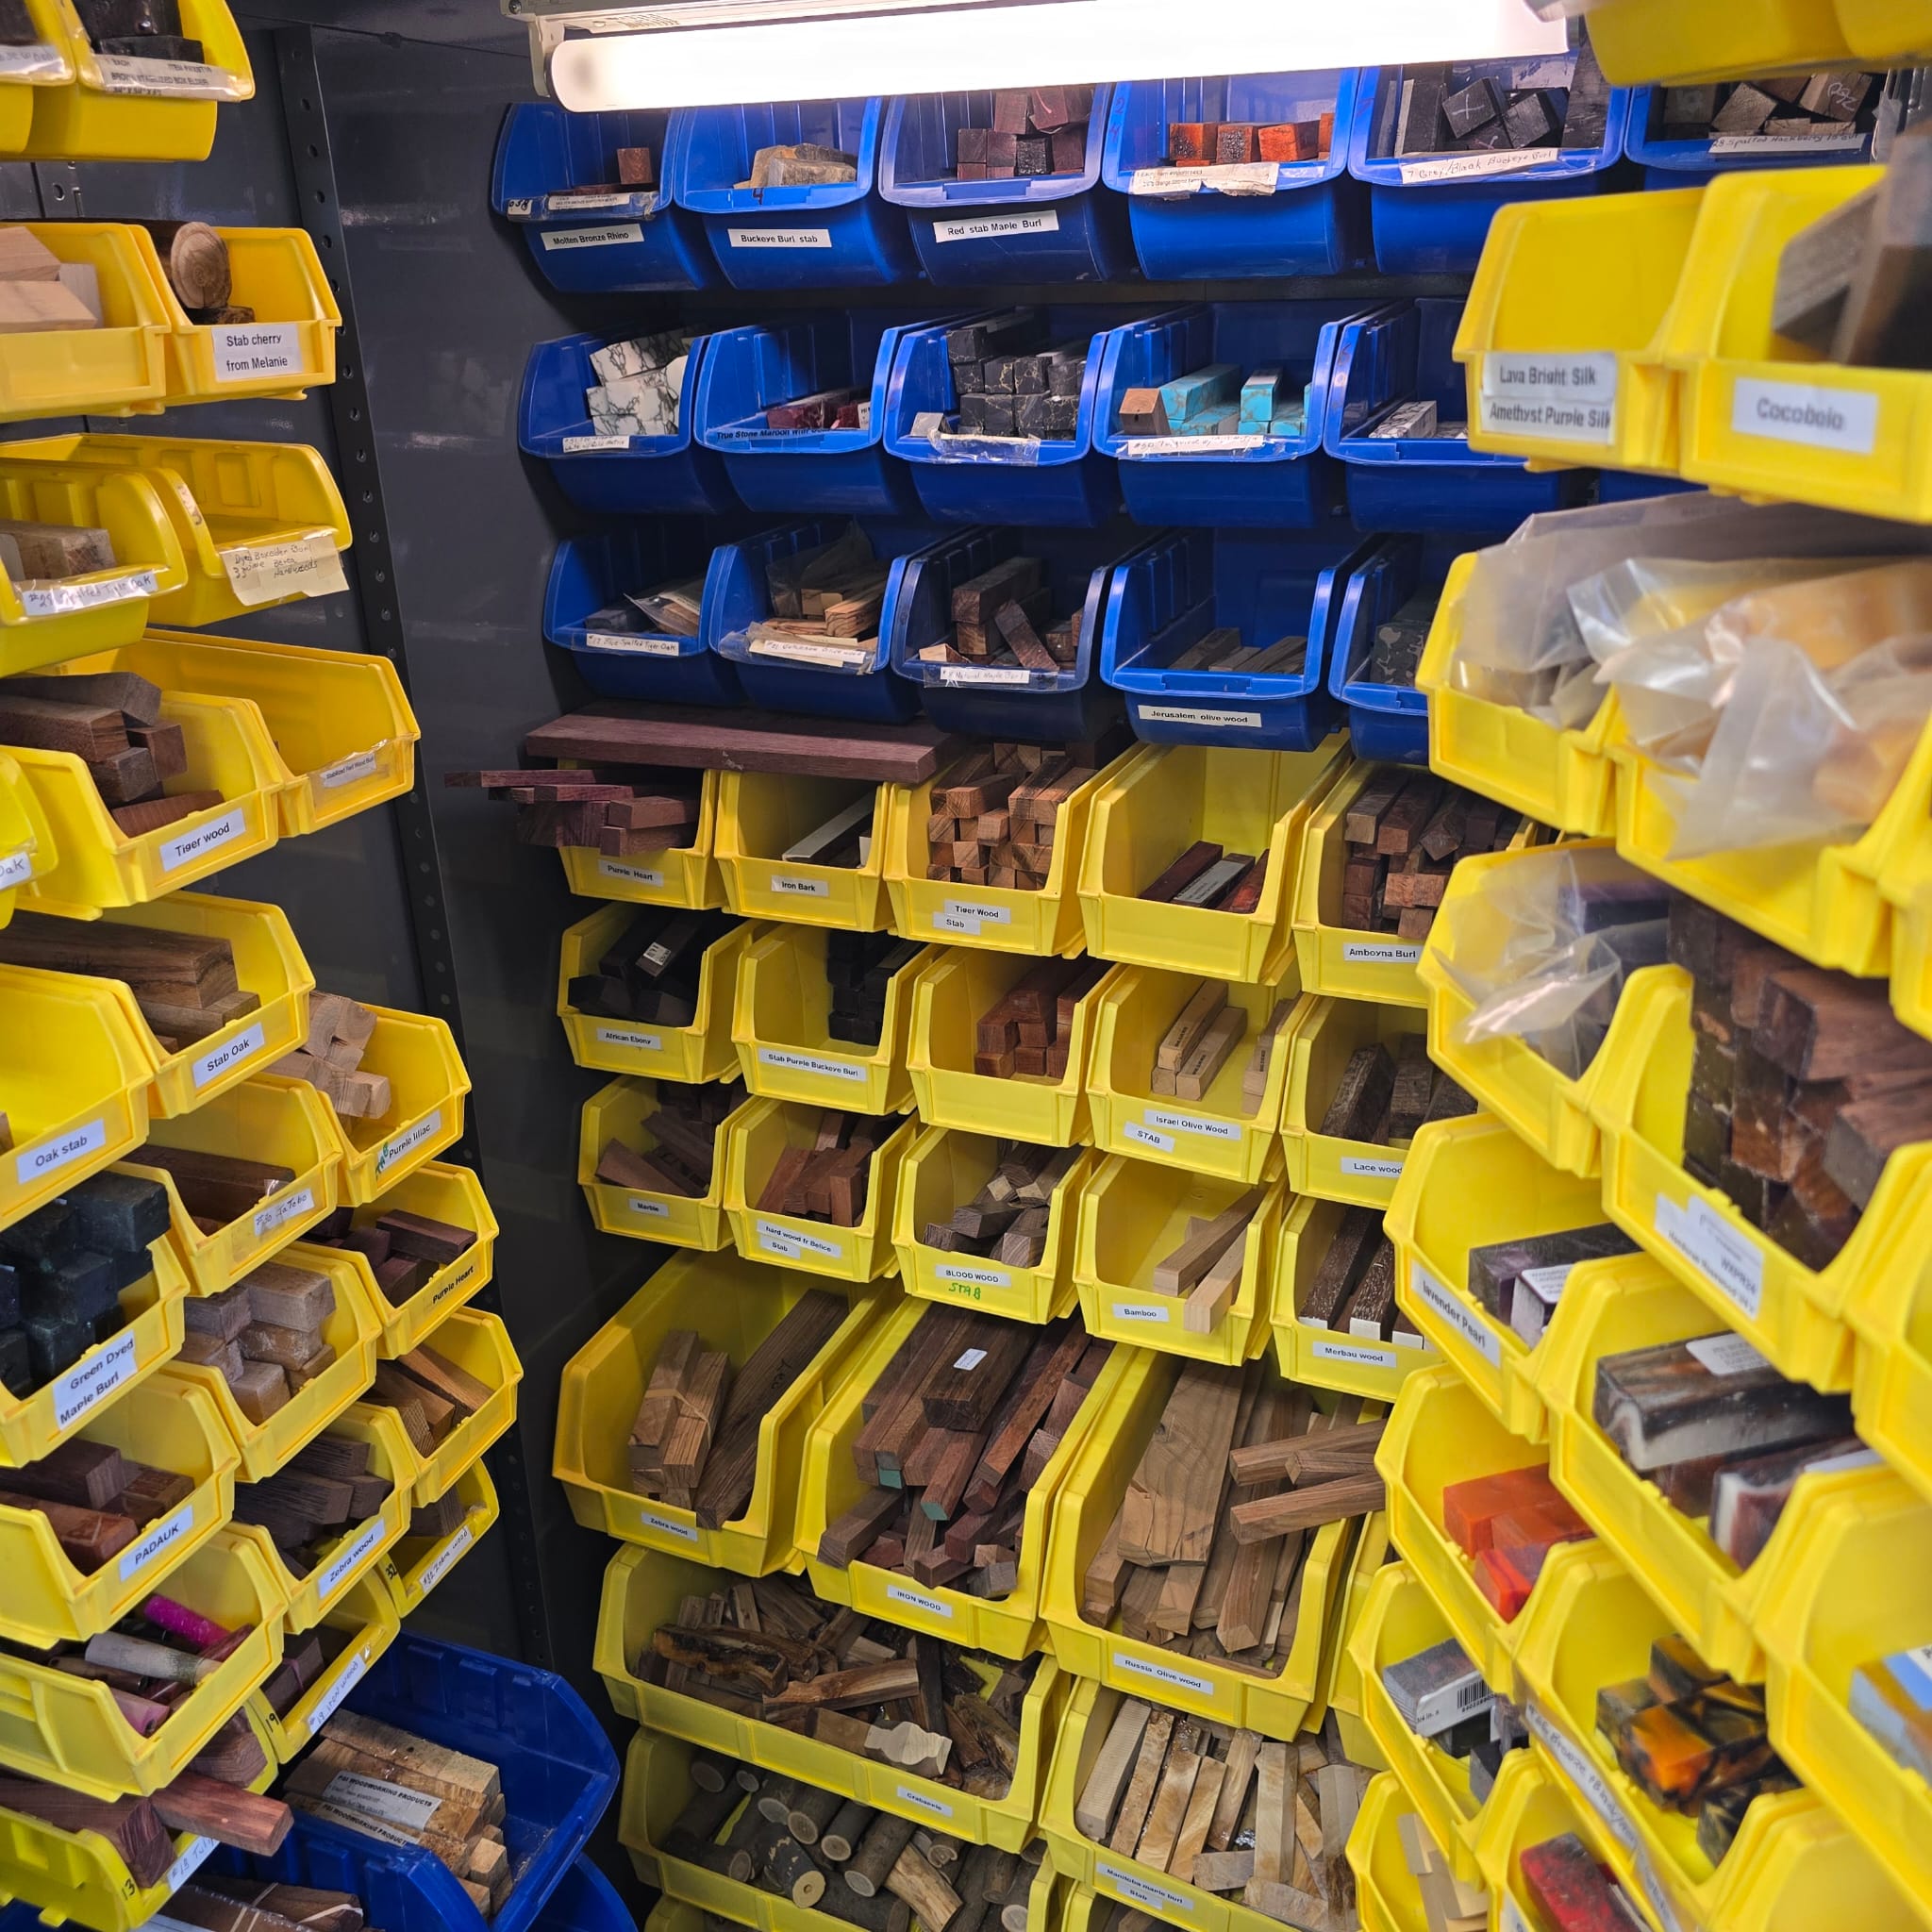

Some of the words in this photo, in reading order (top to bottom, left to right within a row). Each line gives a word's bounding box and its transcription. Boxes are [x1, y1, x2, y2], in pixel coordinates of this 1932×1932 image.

[946, 226, 964, 235] Red
[969, 224, 989, 234] stab
[991, 222, 1017, 232] Maple
[1022, 219, 1041, 228] Burl
[553, 235, 578, 245] Molten
[579, 233, 607, 243] Bronze
[608, 231, 630, 242] Rhino
[741, 234, 776, 243] Buckeye
[777, 234, 795, 242] Burl
[800, 234, 819, 243] stab
[226, 335, 250, 347] Stab
[251, 333, 282, 347] cherry
[226, 359, 251, 372] from
[252, 357, 288, 369] Melanie
[1500, 366, 1524, 384] Lava
[1527, 366, 1565, 386] Bright
[1572, 366, 1595, 385] Silk
[1489, 403, 1543, 425] Amethyst
[1544, 407, 1584, 426] Purple
[1587, 409, 1610, 429] Silk
[1756, 397, 1843, 430] Cocobolo
[717, 430, 734, 440] True
[736, 429, 758, 439] Stone
[760, 428, 791, 438] Maroon
[1150, 710, 1196, 721] Jerusalem
[1200, 712, 1222, 722] olive
[1223, 715, 1248, 724] wood
[175, 838, 201, 857] Tiger
[204, 822, 230, 843] wood
[607, 865, 631, 876] Purple
[633, 871, 653, 881] Heart
[782, 881, 797, 890] Iron
[798, 883, 816, 891] Bark
[955, 905, 975, 914] Tiger
[976, 908, 999, 918] Wood
[945, 919, 964, 928] Stab
[1349, 948, 1392, 958] Amboyna
[1395, 949, 1417, 958] Burl
[606, 1032, 630, 1042] African
[631, 1035, 652, 1045] Ebony
[208, 1052, 230, 1072] Stab
[231, 1039, 250, 1055] Oak
[768, 1053, 786, 1062] Stab
[787, 1057, 810, 1067] Purple
[811, 1061, 841, 1074] Buckeye
[841, 1068, 858, 1076] Burl
[1156, 1115, 1179, 1126] Israel
[1181, 1120, 1204, 1131] Olive
[1205, 1124, 1228, 1135] Wood
[390, 1137, 412, 1158] Purple
[413, 1124, 431, 1141] liliac
[1137, 1129, 1160, 1144] STAB
[35, 1149, 59, 1167] Oak
[61, 1136, 88, 1155] stab
[1354, 1162, 1376, 1172] Lace
[1377, 1165, 1402, 1174] wood
[766, 1225, 781, 1236] hard
[783, 1230, 802, 1242] wood
[772, 1241, 789, 1252] Stab
[433, 1282, 455, 1305] Purple
[455, 1266, 474, 1286] Heart
[945, 1270, 974, 1279] BLOOD
[974, 1273, 999, 1283] WOOD
[948, 1283, 981, 1301] STAB
[1124, 1308, 1157, 1317] Bamboo
[1423, 1280, 1461, 1321] lavender
[1461, 1309, 1486, 1349] Pearl
[1325, 1347, 1357, 1358] Merbau
[1359, 1352, 1383, 1362] wood
[70, 1357, 104, 1390] Green
[105, 1339, 134, 1367] Dyed
[60, 1394, 93, 1424] Maple
[95, 1372, 119, 1395] Burl
[650, 1518, 670, 1529] Zebra
[670, 1524, 688, 1536] wood
[134, 1523, 179, 1565] PADAUK
[330, 1558, 352, 1583] Zebra
[352, 1534, 375, 1561] wood
[896, 1591, 917, 1603] IRON
[917, 1597, 941, 1611] WOOD
[1124, 1659, 1153, 1673] Russia
[1157, 1669, 1177, 1680] Olive
[1178, 1676, 1201, 1688] wood
[265, 1712, 279, 1733] 19
[337, 1774, 349, 1783] PSI
[349, 1776, 398, 1797] WOODWORKING
[397, 1791, 433, 1807] PRODUCTS
[322, 1803, 333, 1811] PSI
[333, 1807, 378, 1832] WOODWORKING
[122, 1878, 136, 1901] 13
[1107, 1869, 1141, 1888] Manitoba
[1141, 1883, 1165, 1897] maple
[1166, 1892, 1183, 1904] burl
[1129, 1889, 1147, 1901] Stab
